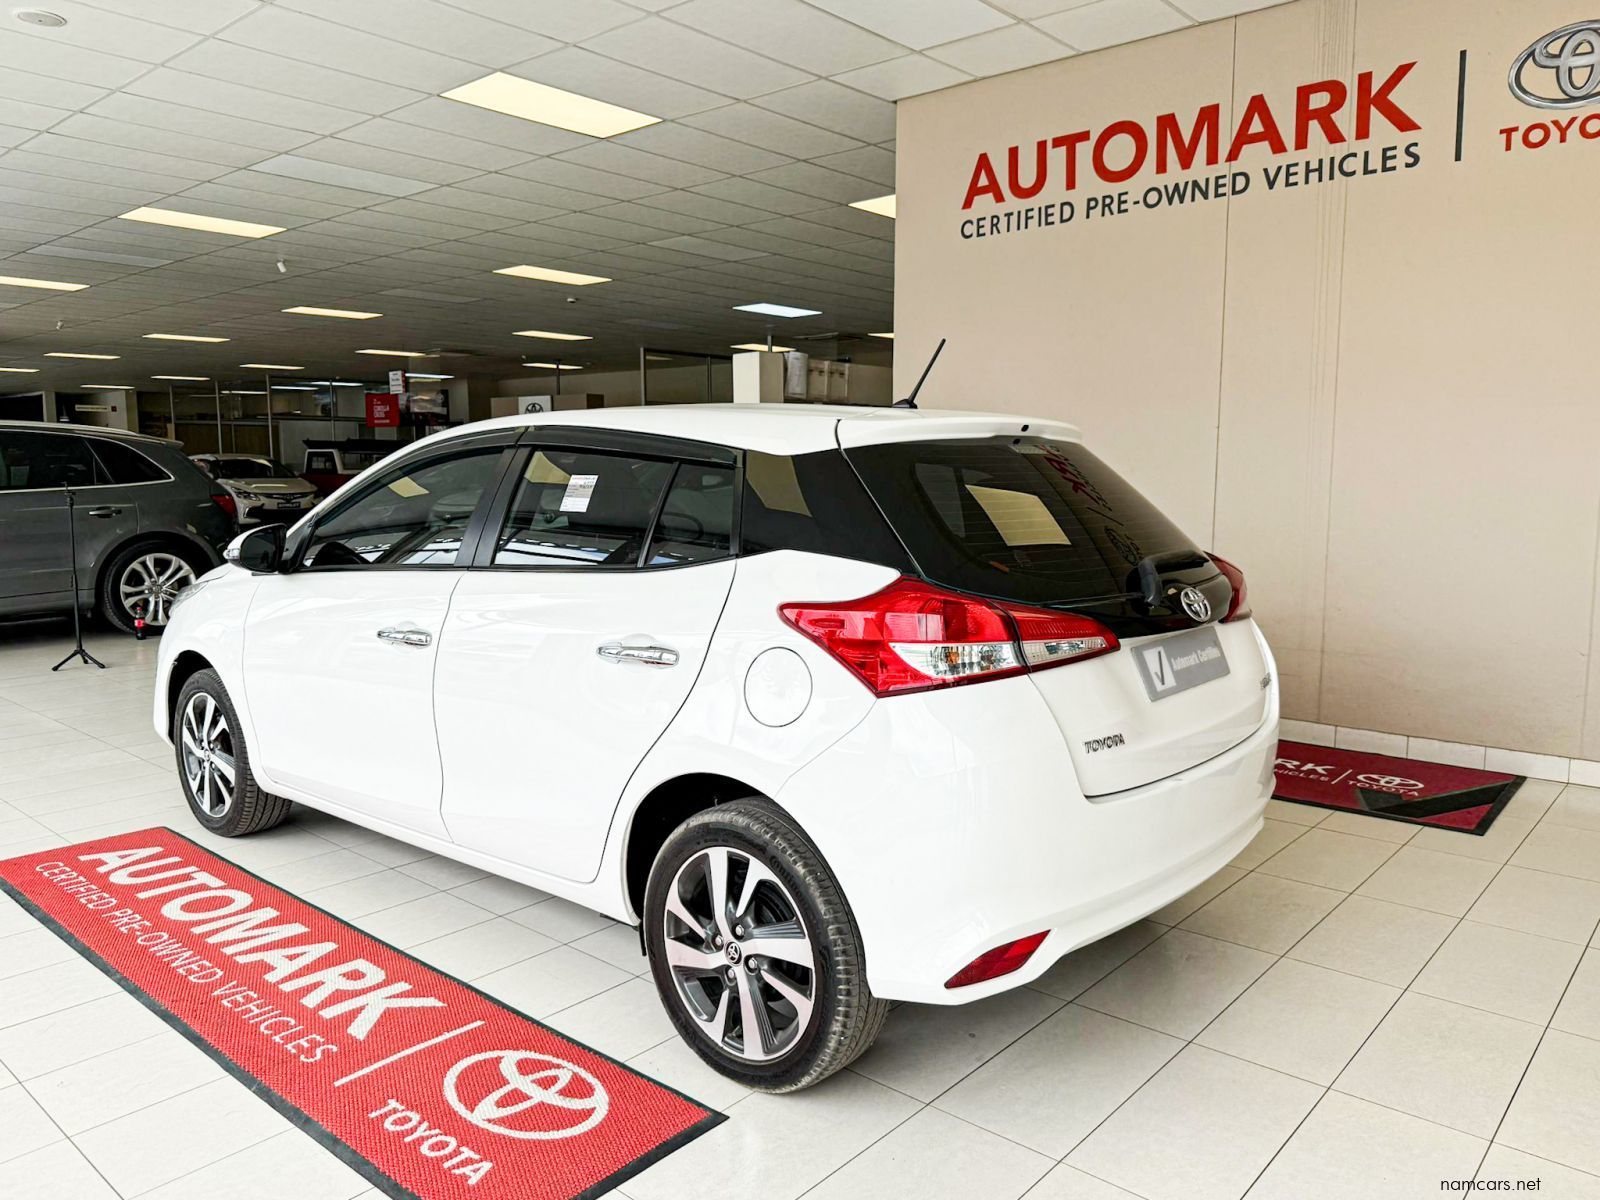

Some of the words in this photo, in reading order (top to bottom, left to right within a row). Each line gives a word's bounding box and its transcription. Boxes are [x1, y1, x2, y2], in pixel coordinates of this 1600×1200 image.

[961, 61, 1423, 211] AUTOMARK
[960, 201, 1076, 240] CERTIFIED
[1085, 171, 1251, 220] PRE-OWNED
[1262, 142, 1421, 191] VEHICLES
[1084, 733, 1126, 754] TOYOTA
[1347, 779, 1420, 797] TOYOTA
[35, 861, 119, 911] CERTIFIED
[106, 907, 224, 984] PRE-OWNED
[211, 979, 338, 1064] VEHICLES
[78, 846, 447, 1041] AUTOMARK
[367, 1098, 494, 1186] TOYOTA
